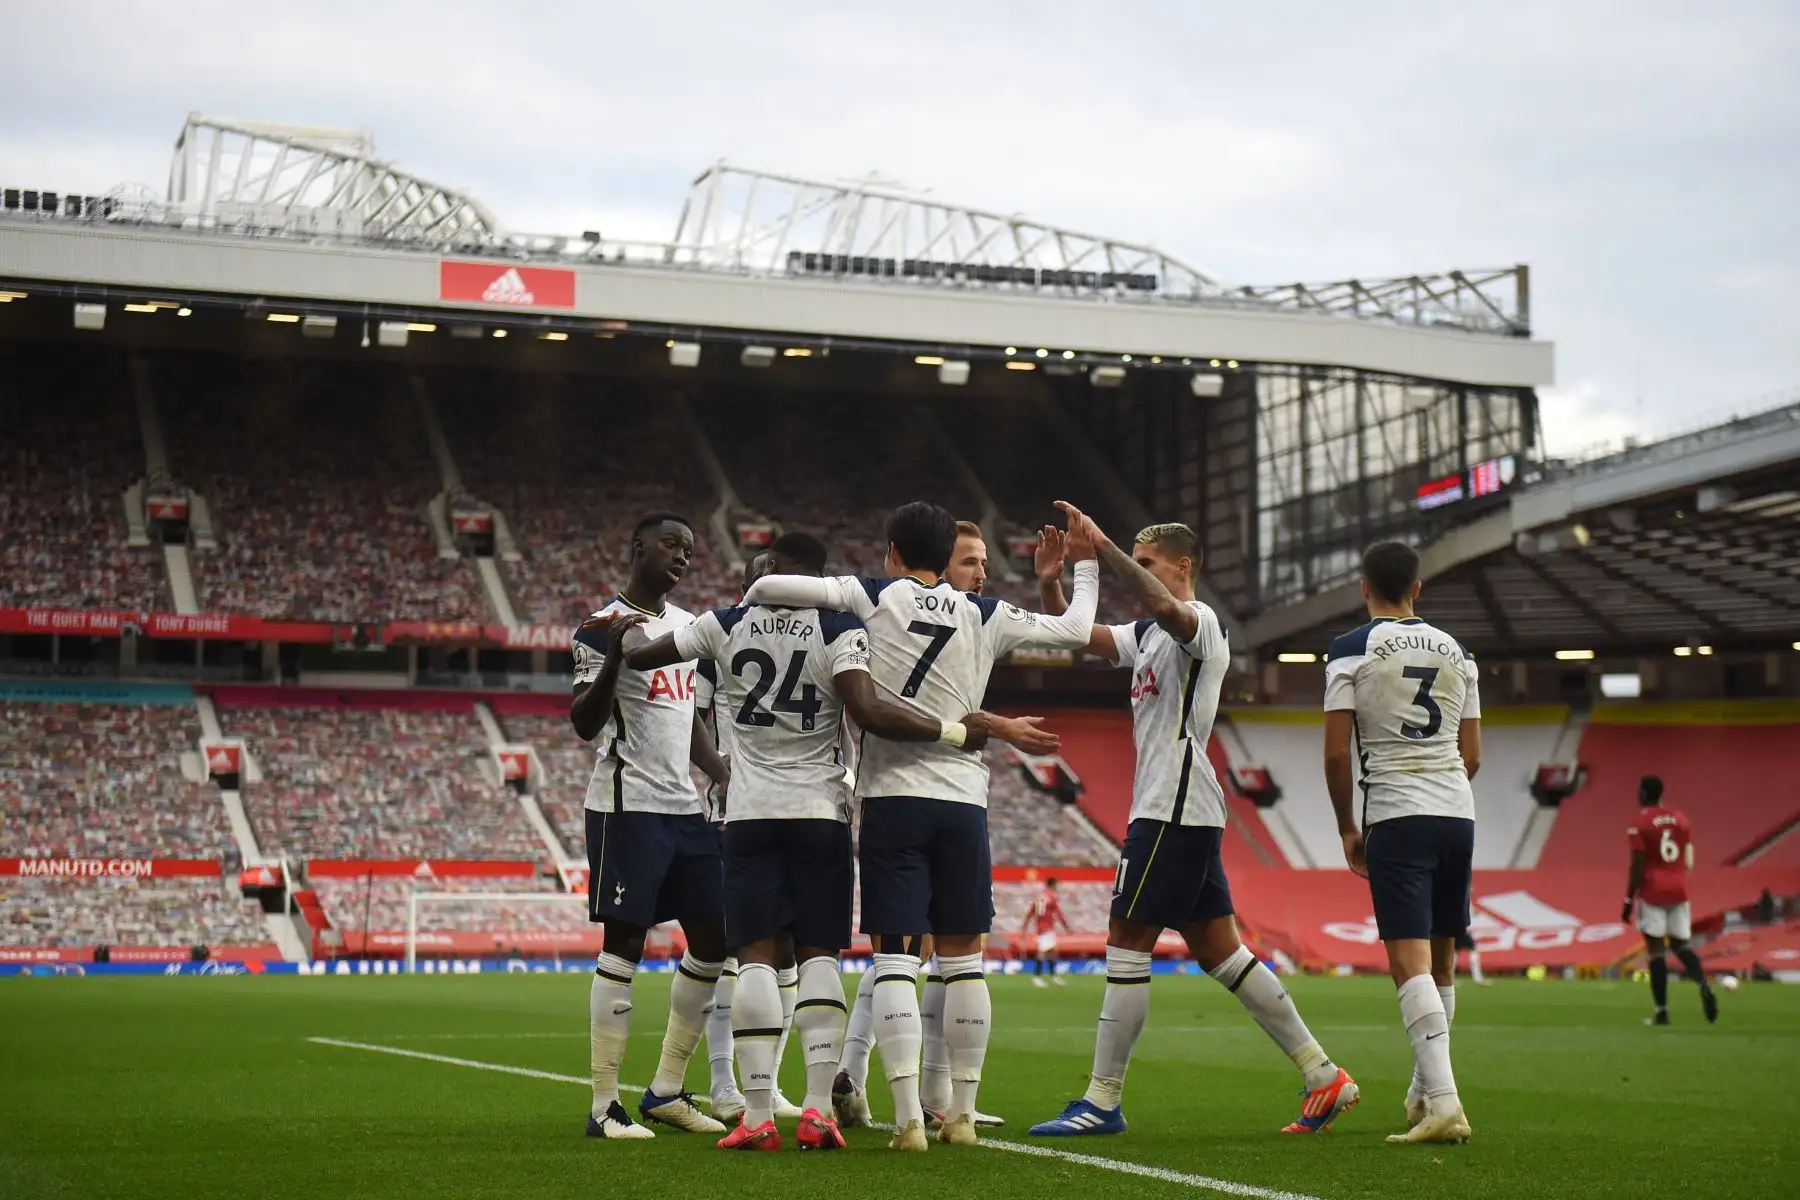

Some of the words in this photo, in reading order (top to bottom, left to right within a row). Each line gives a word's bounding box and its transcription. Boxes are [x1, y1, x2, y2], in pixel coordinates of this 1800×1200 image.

[915, 595, 956, 615] SON
[27, 611, 48, 627] THE
[52, 612, 86, 629] QUIET
[90, 614, 117, 630] MAN
[155, 616, 184, 632] TONY
[750, 618, 814, 642] AURIER
[507, 625, 574, 647] MAN
[900, 619, 957, 699] 7
[1373, 635, 1461, 666] REGUILÓN
[731, 647, 823, 731] 24
[1400, 665, 1443, 739] 3
[1660, 828, 1680, 863] 6
[19, 858, 153, 877] MANUTD.COM
[884, 1011, 913, 1021] SPURS
[955, 1017, 984, 1026] SPURS
[809, 1041, 832, 1052] SPURS
[750, 1072, 771, 1080] SPURS
